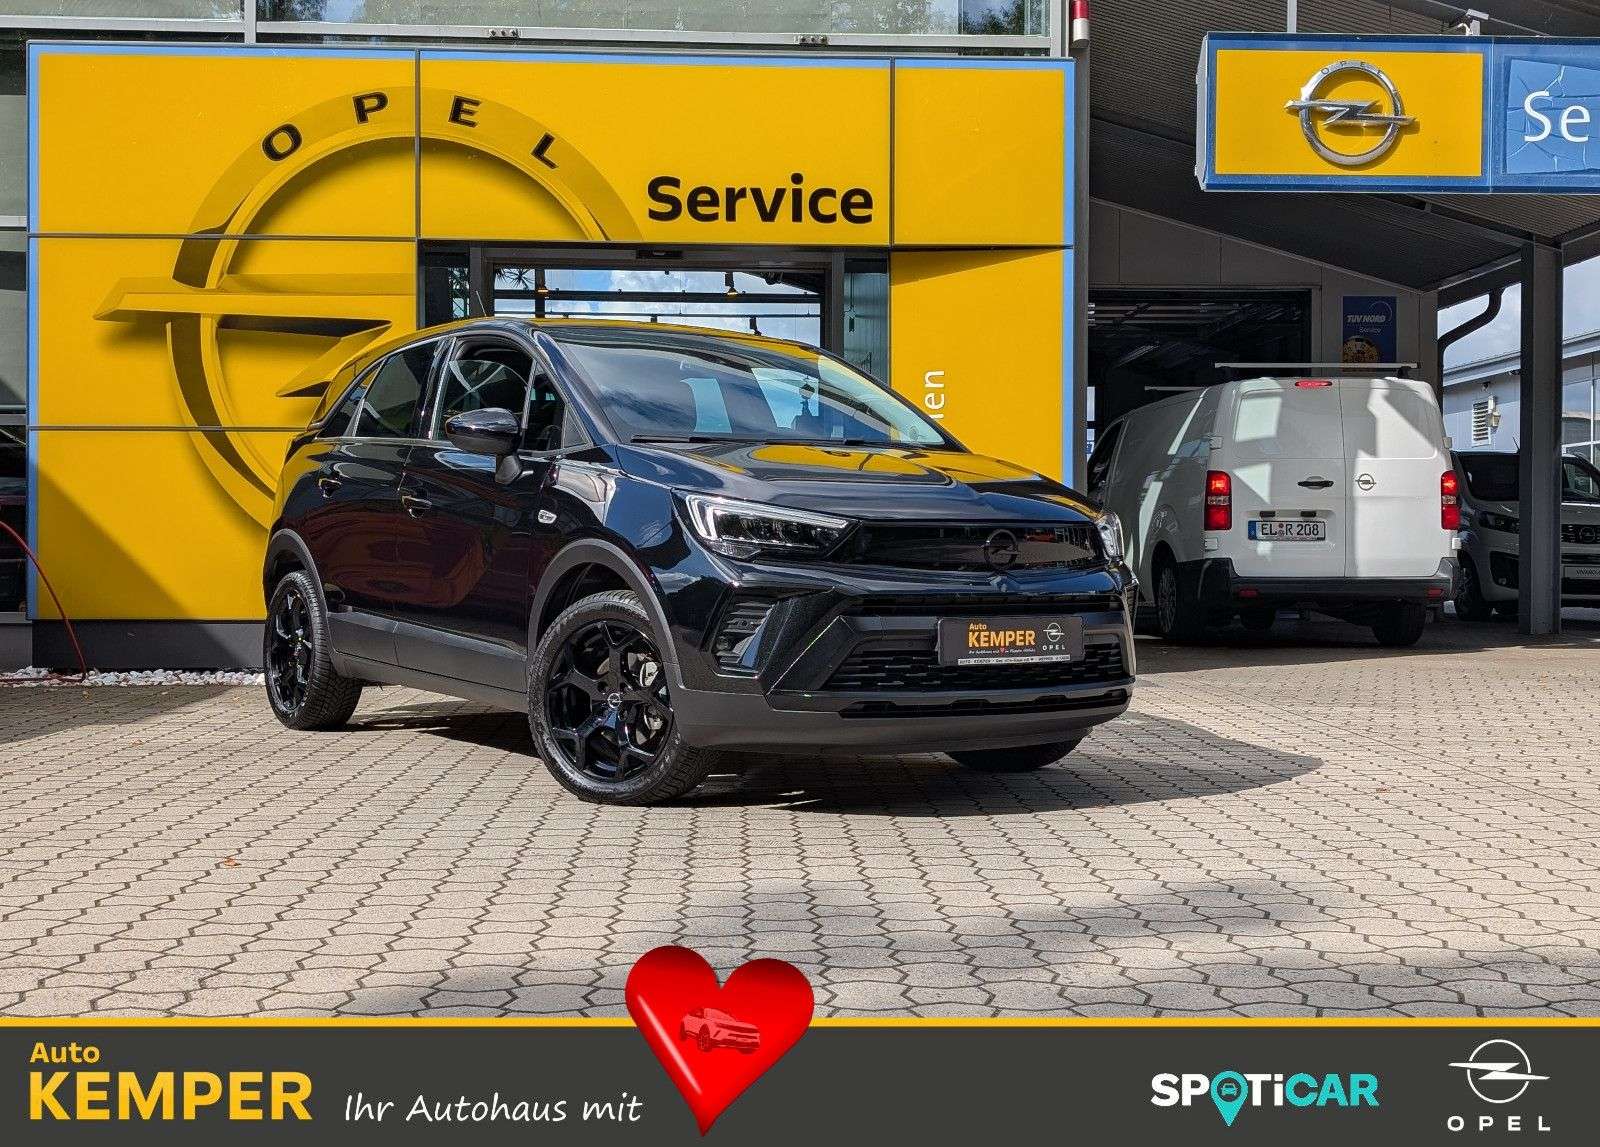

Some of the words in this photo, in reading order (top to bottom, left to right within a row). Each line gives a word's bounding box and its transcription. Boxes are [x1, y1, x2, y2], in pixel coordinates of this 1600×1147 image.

[1321, 61, 1383, 77] OPEL
[1524, 90, 1591, 142] Se
[262, 91, 560, 169] OPEL
[647, 173, 873, 224] Service
[1363, 314, 1386, 323] NORD
[1261, 523, 1277, 536] EL
[1285, 523, 1294, 536] R
[1296, 523, 1319, 536] 208
[968, 630, 1036, 648] KEMPER
